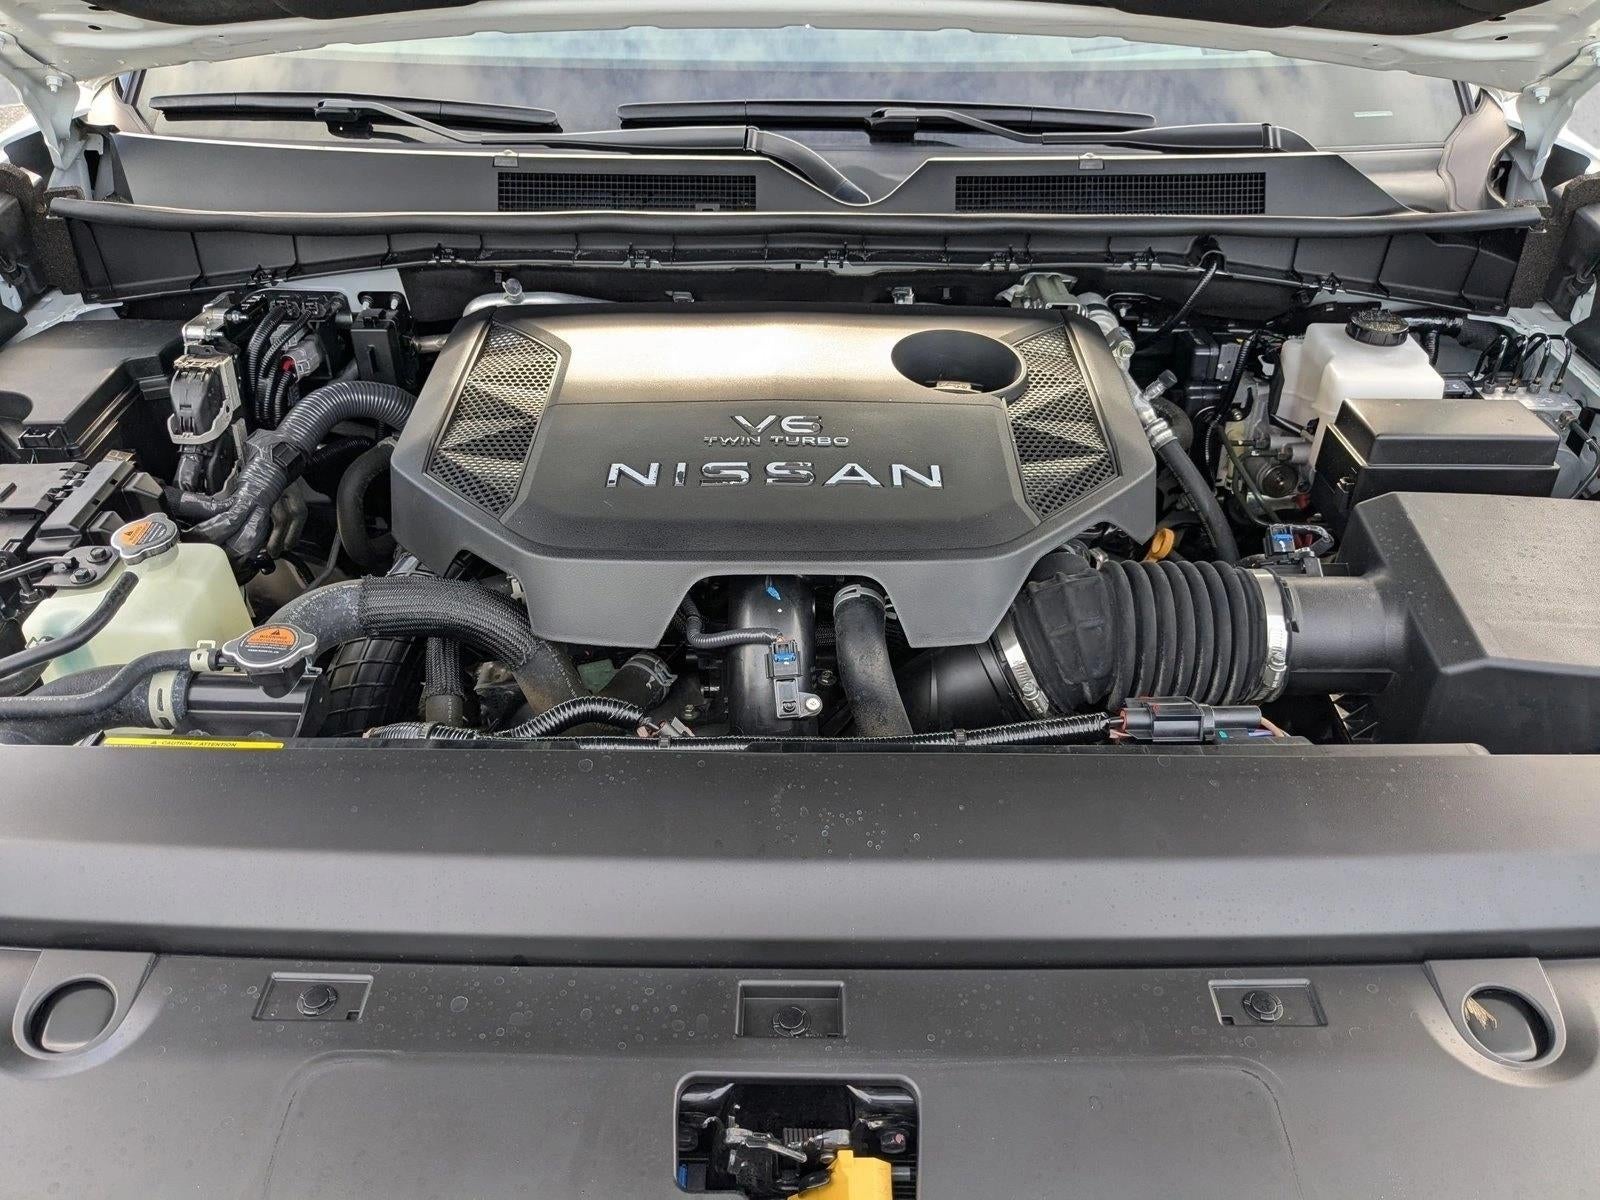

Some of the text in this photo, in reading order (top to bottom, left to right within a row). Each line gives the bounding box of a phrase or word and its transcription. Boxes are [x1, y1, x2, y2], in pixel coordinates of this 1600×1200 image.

[730, 414, 823, 436] V6
[703, 435, 850, 448] TWIN TURBO
[605, 460, 945, 490] NISSAN
